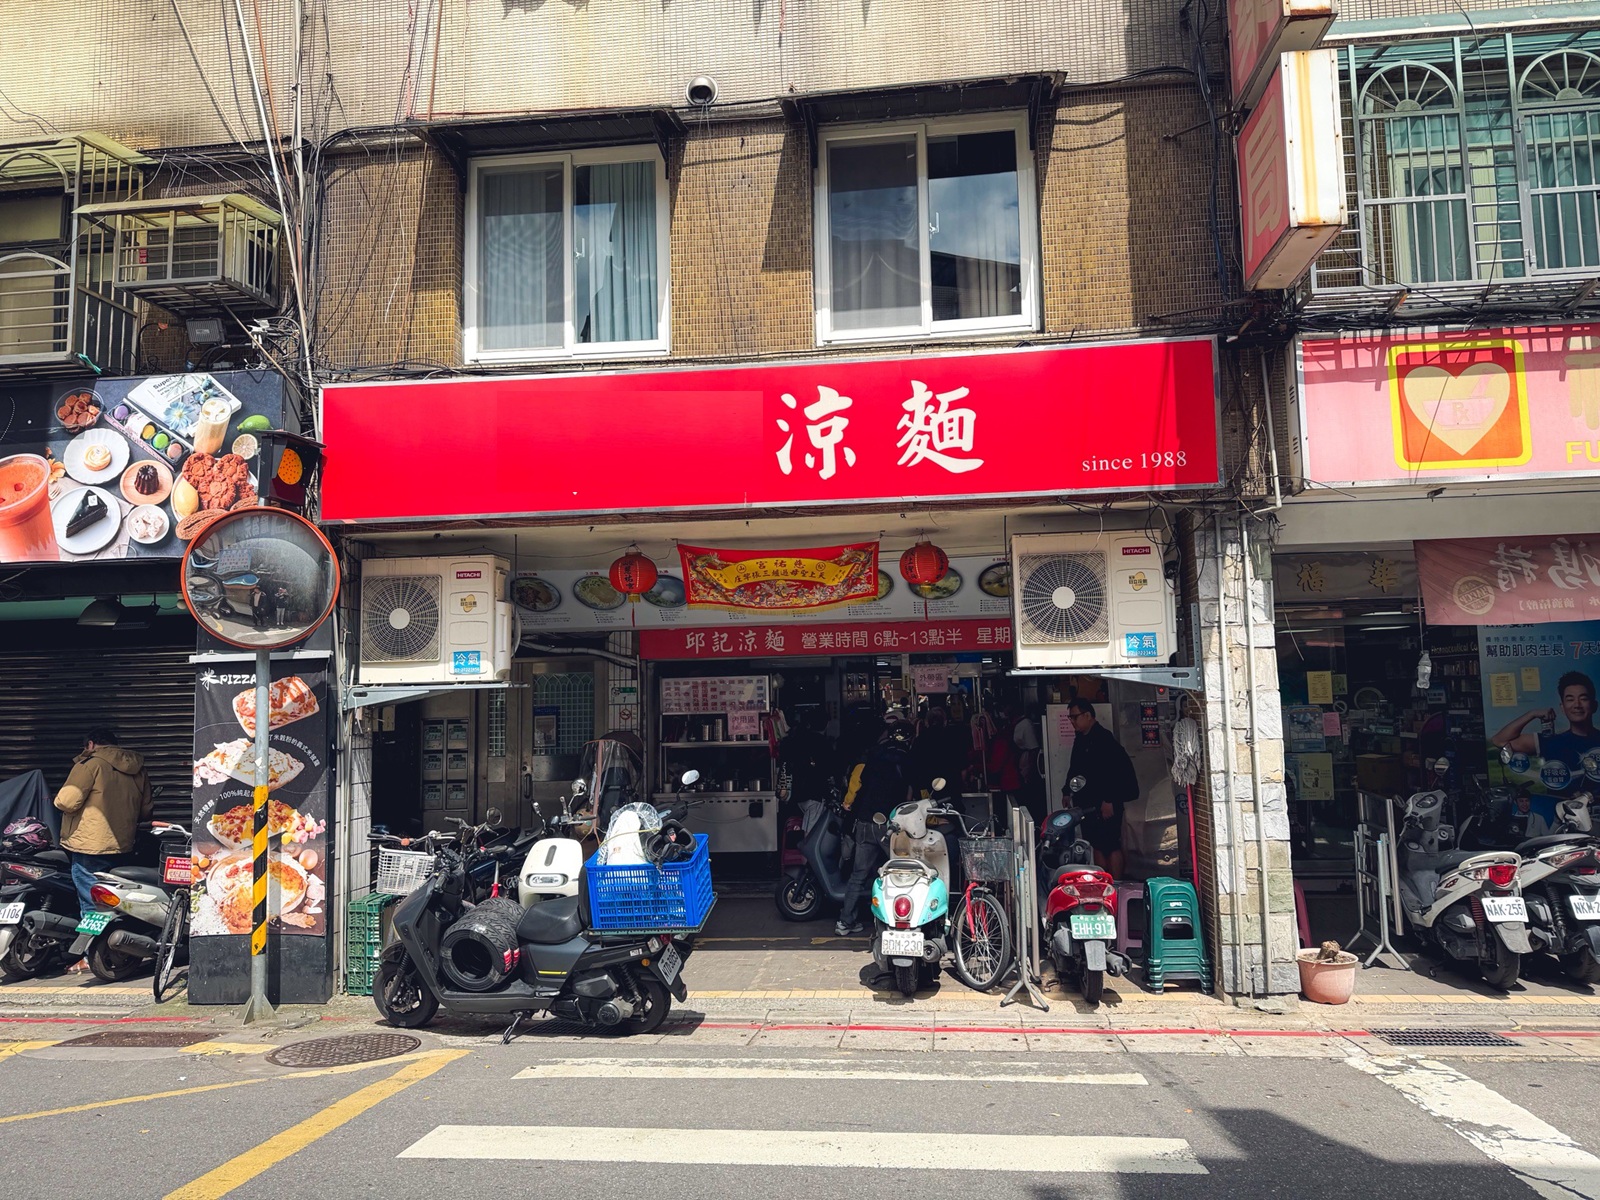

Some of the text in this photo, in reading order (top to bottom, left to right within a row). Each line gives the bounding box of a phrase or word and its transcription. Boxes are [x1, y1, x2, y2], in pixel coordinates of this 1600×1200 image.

[776, 380, 984, 480] 涼麵
[1082, 451, 1188, 472] since 1988
[685, 628, 786, 655] 邱記涼麵
[801, 629, 868, 649] 營業時間
[976, 626, 1012, 645] 星期
[1128, 634, 1156, 648] 冷氣
[1485, 643, 1565, 658] 幫助肌肉生長
[455, 653, 480, 665] 冷氣
[1072, 923, 1115, 936] EHH-917
